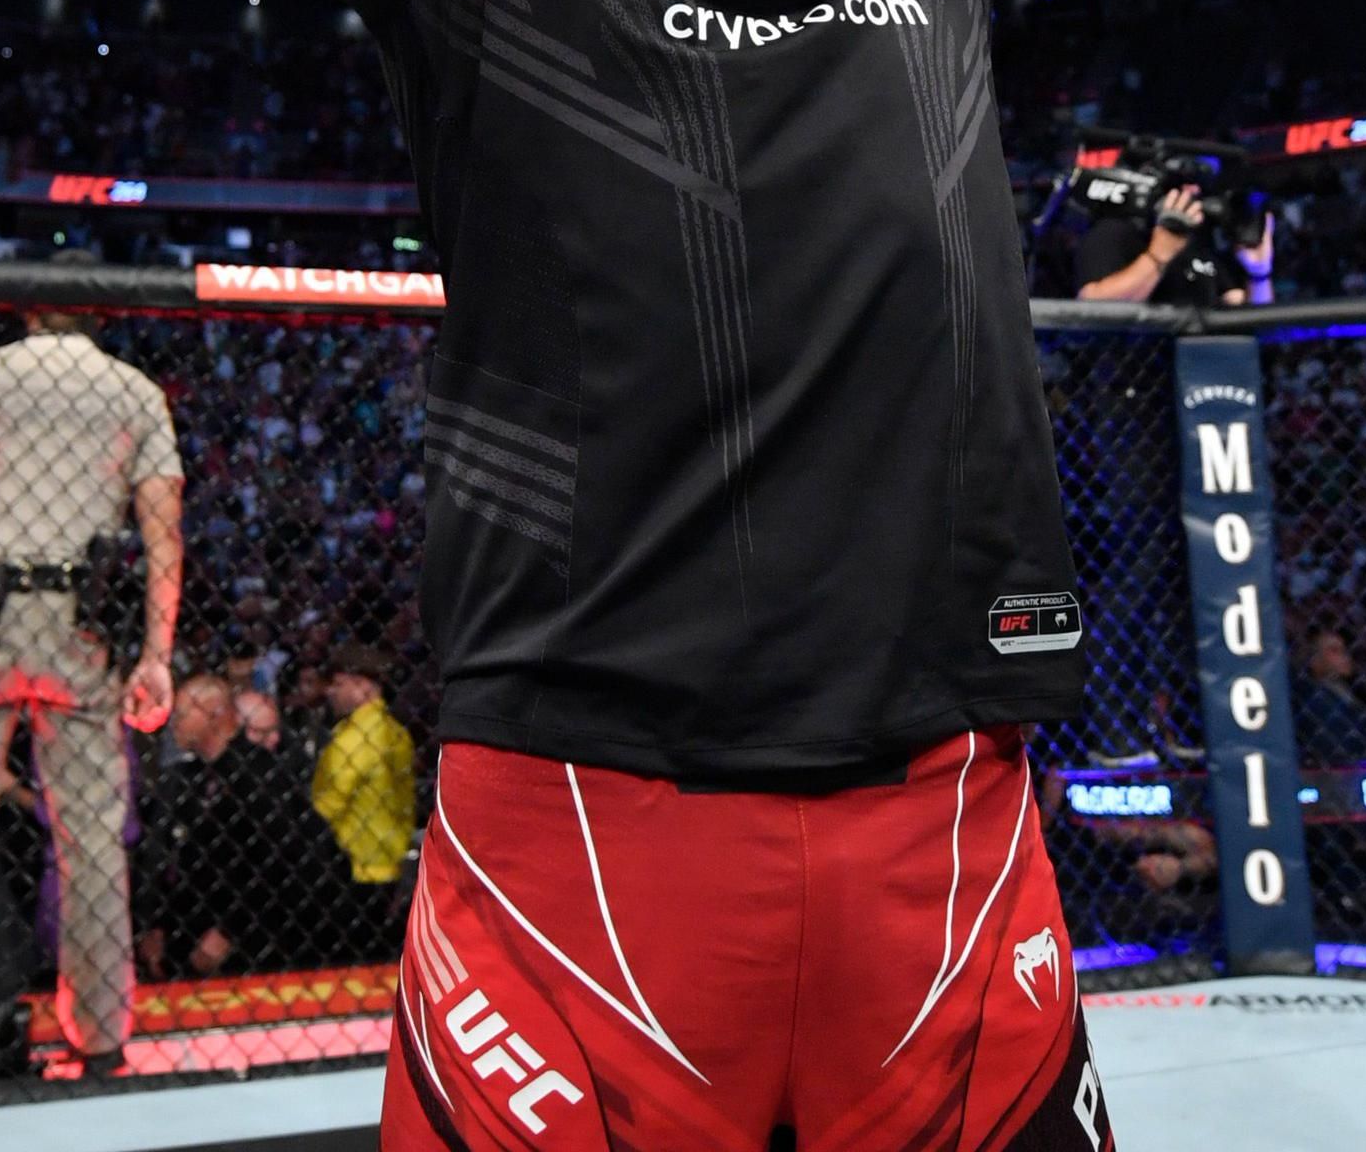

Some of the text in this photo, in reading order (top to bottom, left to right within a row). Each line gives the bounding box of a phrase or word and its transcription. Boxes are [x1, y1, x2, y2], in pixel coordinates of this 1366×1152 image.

[1285, 117, 1354, 155] UFC
[1086, 179, 1131, 205] UFC
[1003, 595, 1067, 608] AUTHENTIC PRODUCT
[998, 615, 1032, 632] UFC
[1196, 421, 1286, 906] Modelo
[446, 988, 585, 1135] UFC
